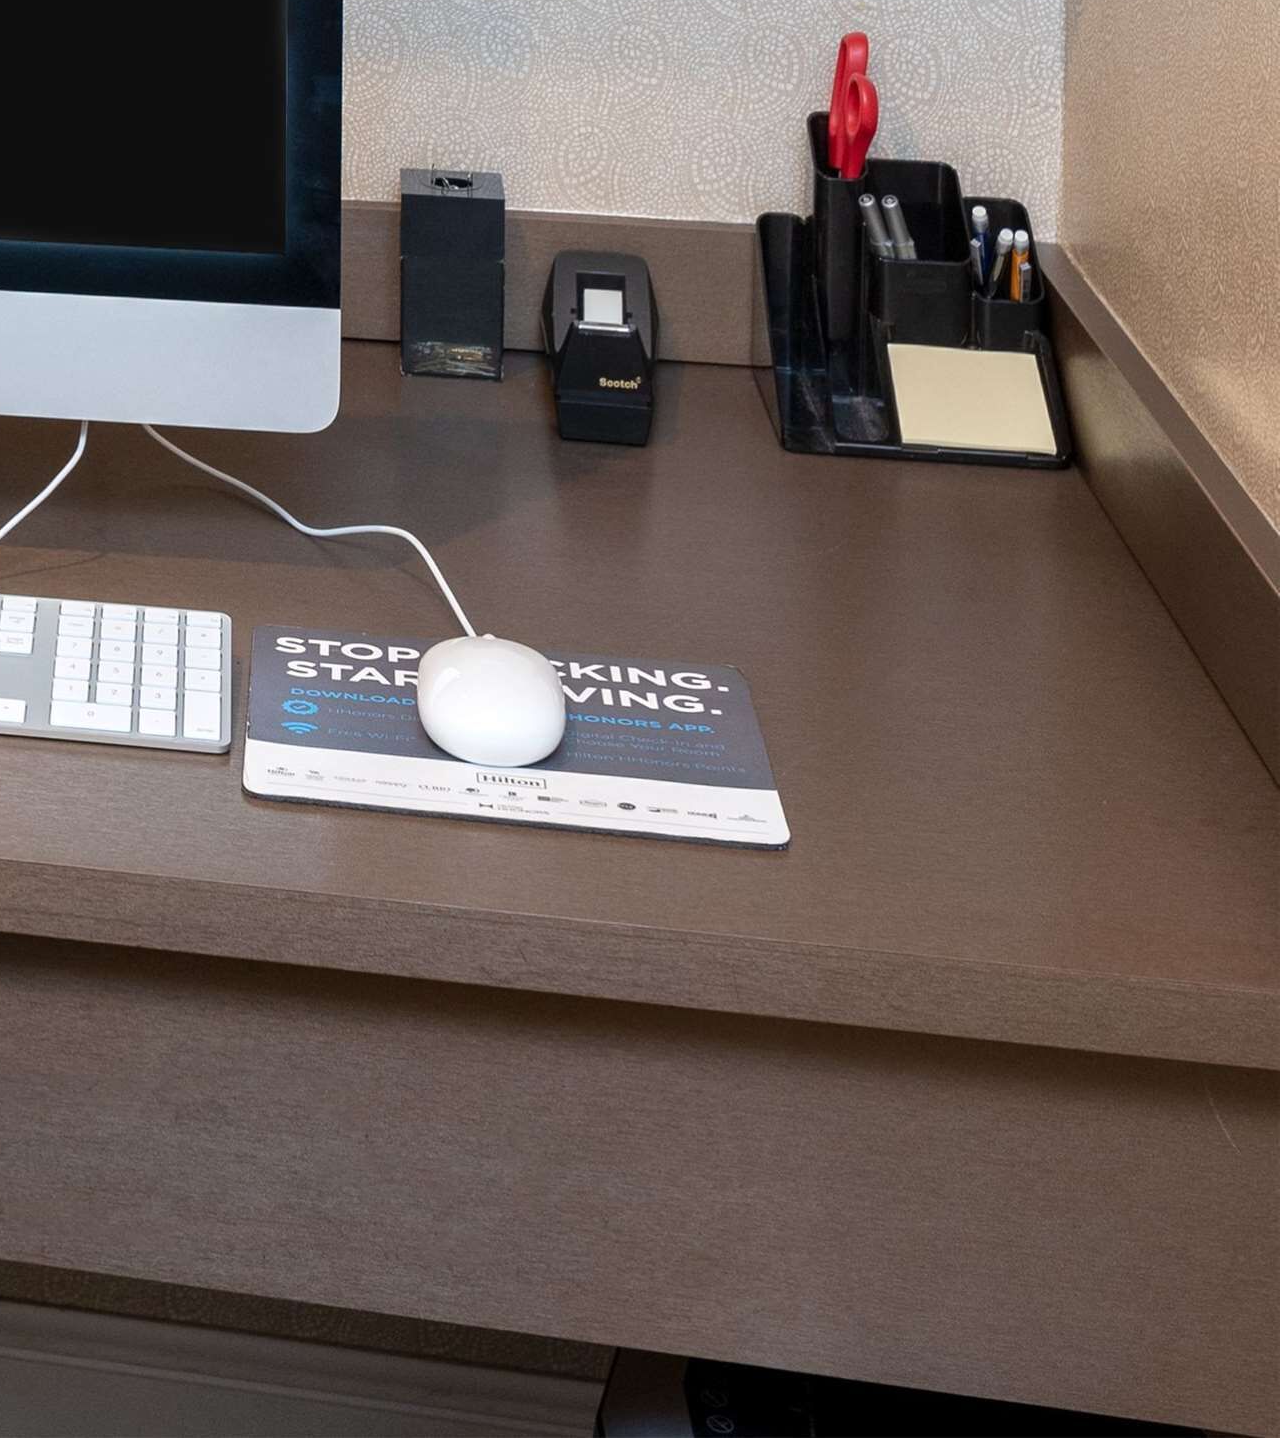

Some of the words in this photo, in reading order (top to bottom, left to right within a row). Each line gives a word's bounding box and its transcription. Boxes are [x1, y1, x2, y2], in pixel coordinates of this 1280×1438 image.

[275, 636, 420, 663] STOP
[286, 660, 419, 687] STAR
[290, 687, 416, 706] DOWNLOAD
[668, 721, 716, 734] APP.
[482, 774, 541, 788] Hilton
